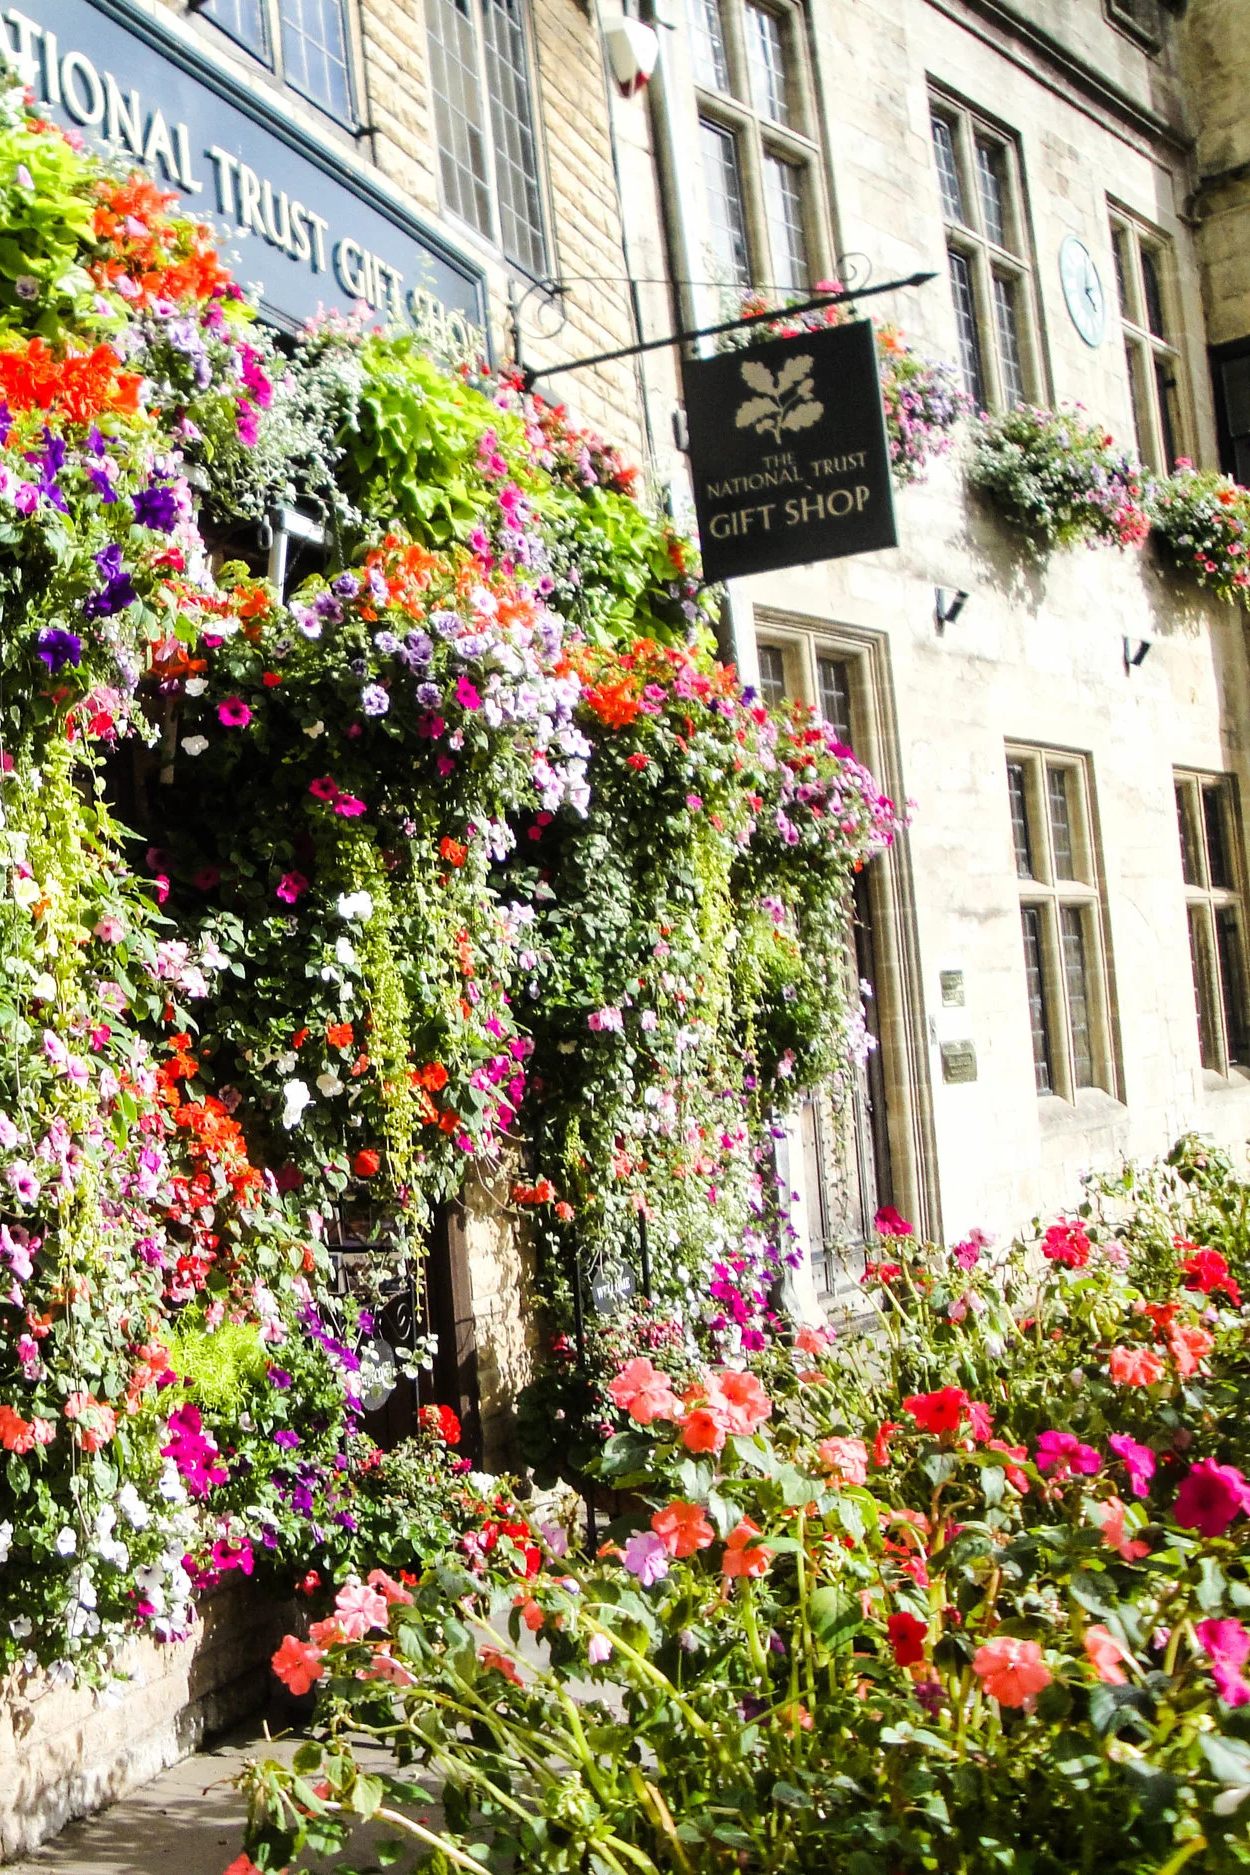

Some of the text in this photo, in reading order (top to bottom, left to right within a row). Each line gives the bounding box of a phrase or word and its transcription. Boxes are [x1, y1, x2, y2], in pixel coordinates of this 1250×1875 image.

[206, 145, 328, 273] TRUST
[335, 237, 403, 322] GIFT
[705, 451, 867, 500] NATIONAL TRUST
[761, 451, 797, 469] THE
[709, 485, 871, 539] GIFT SHOP
